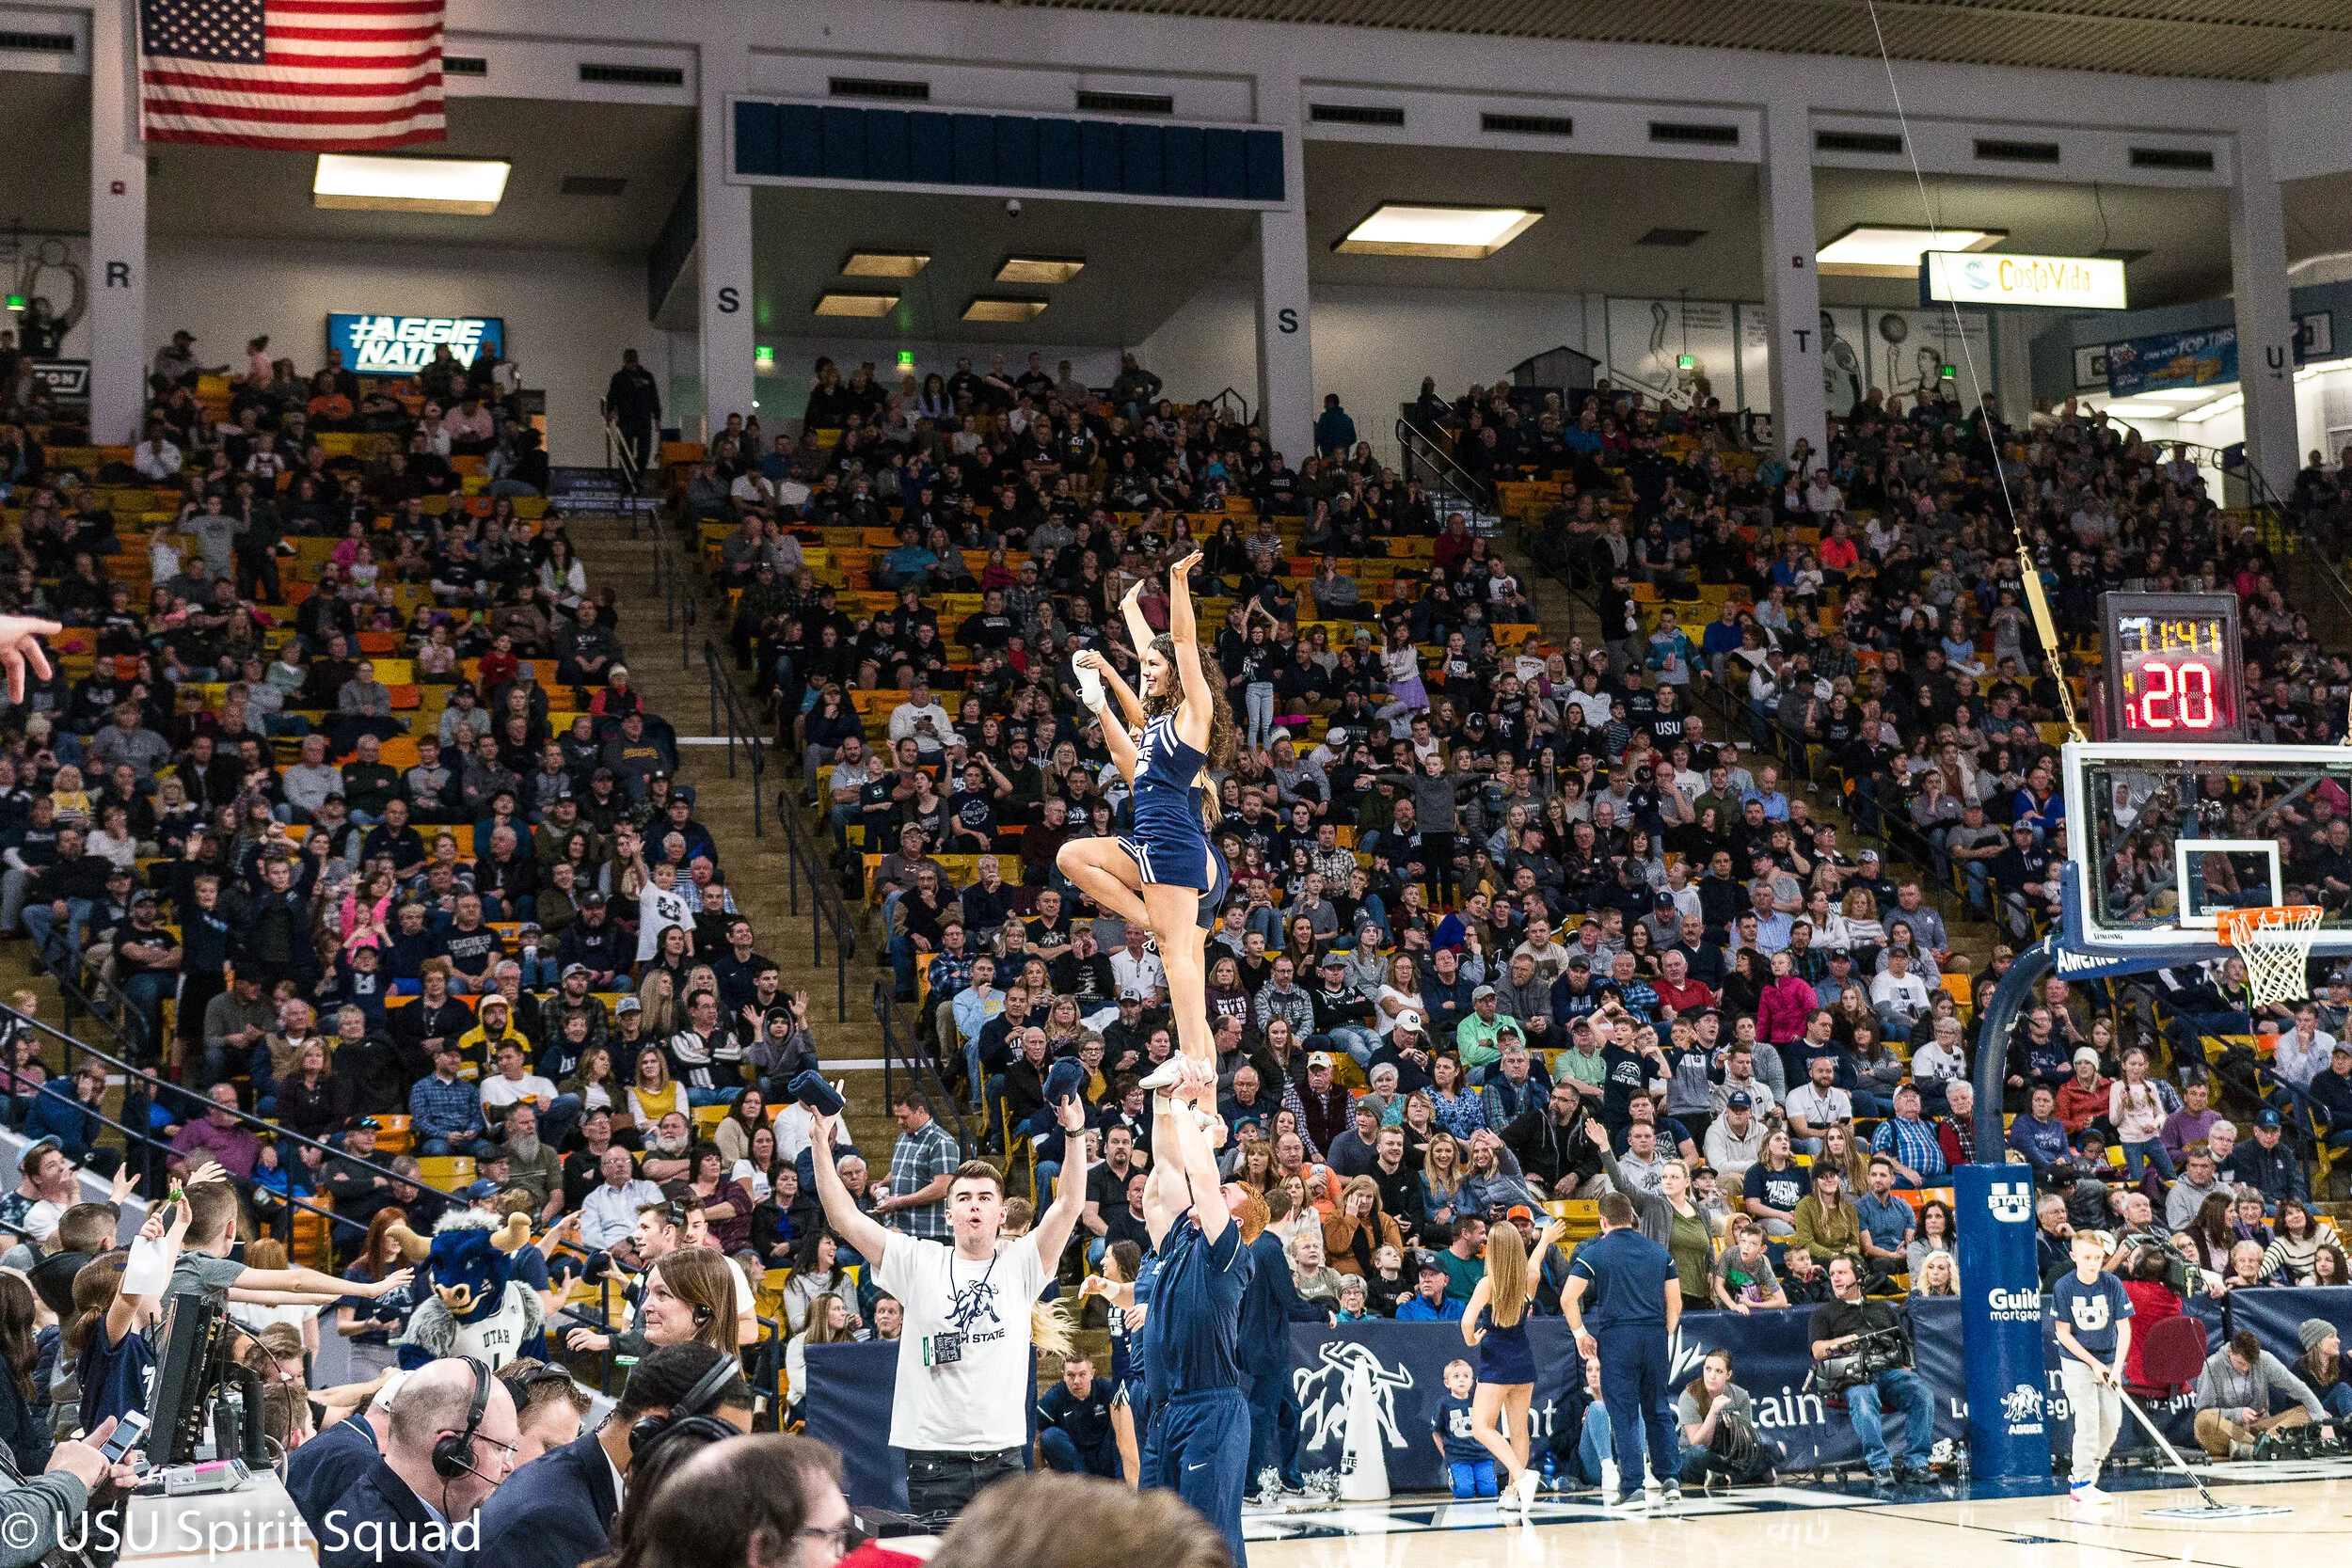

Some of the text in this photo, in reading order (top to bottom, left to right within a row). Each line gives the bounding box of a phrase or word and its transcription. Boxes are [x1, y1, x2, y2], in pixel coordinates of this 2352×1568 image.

[105, 261, 130, 288] R
[718, 288, 739, 312] S
[349, 316, 485, 348] #AGGIE
[1279, 309, 1298, 333] S
[1793, 329, 1810, 353] T
[357, 341, 478, 369] NATIN
[2266, 346, 2283, 370] U
[2141, 662, 2215, 729] 20
[1655, 721, 1680, 736] USU
[2093, 932, 2123, 941] SPALDING
[1988, 1195, 2032, 1209] STATE
[1989, 1288, 2041, 1311] Guild
[483, 1328, 511, 1348] UTAH
[973, 1328, 1006, 1343] STATE
